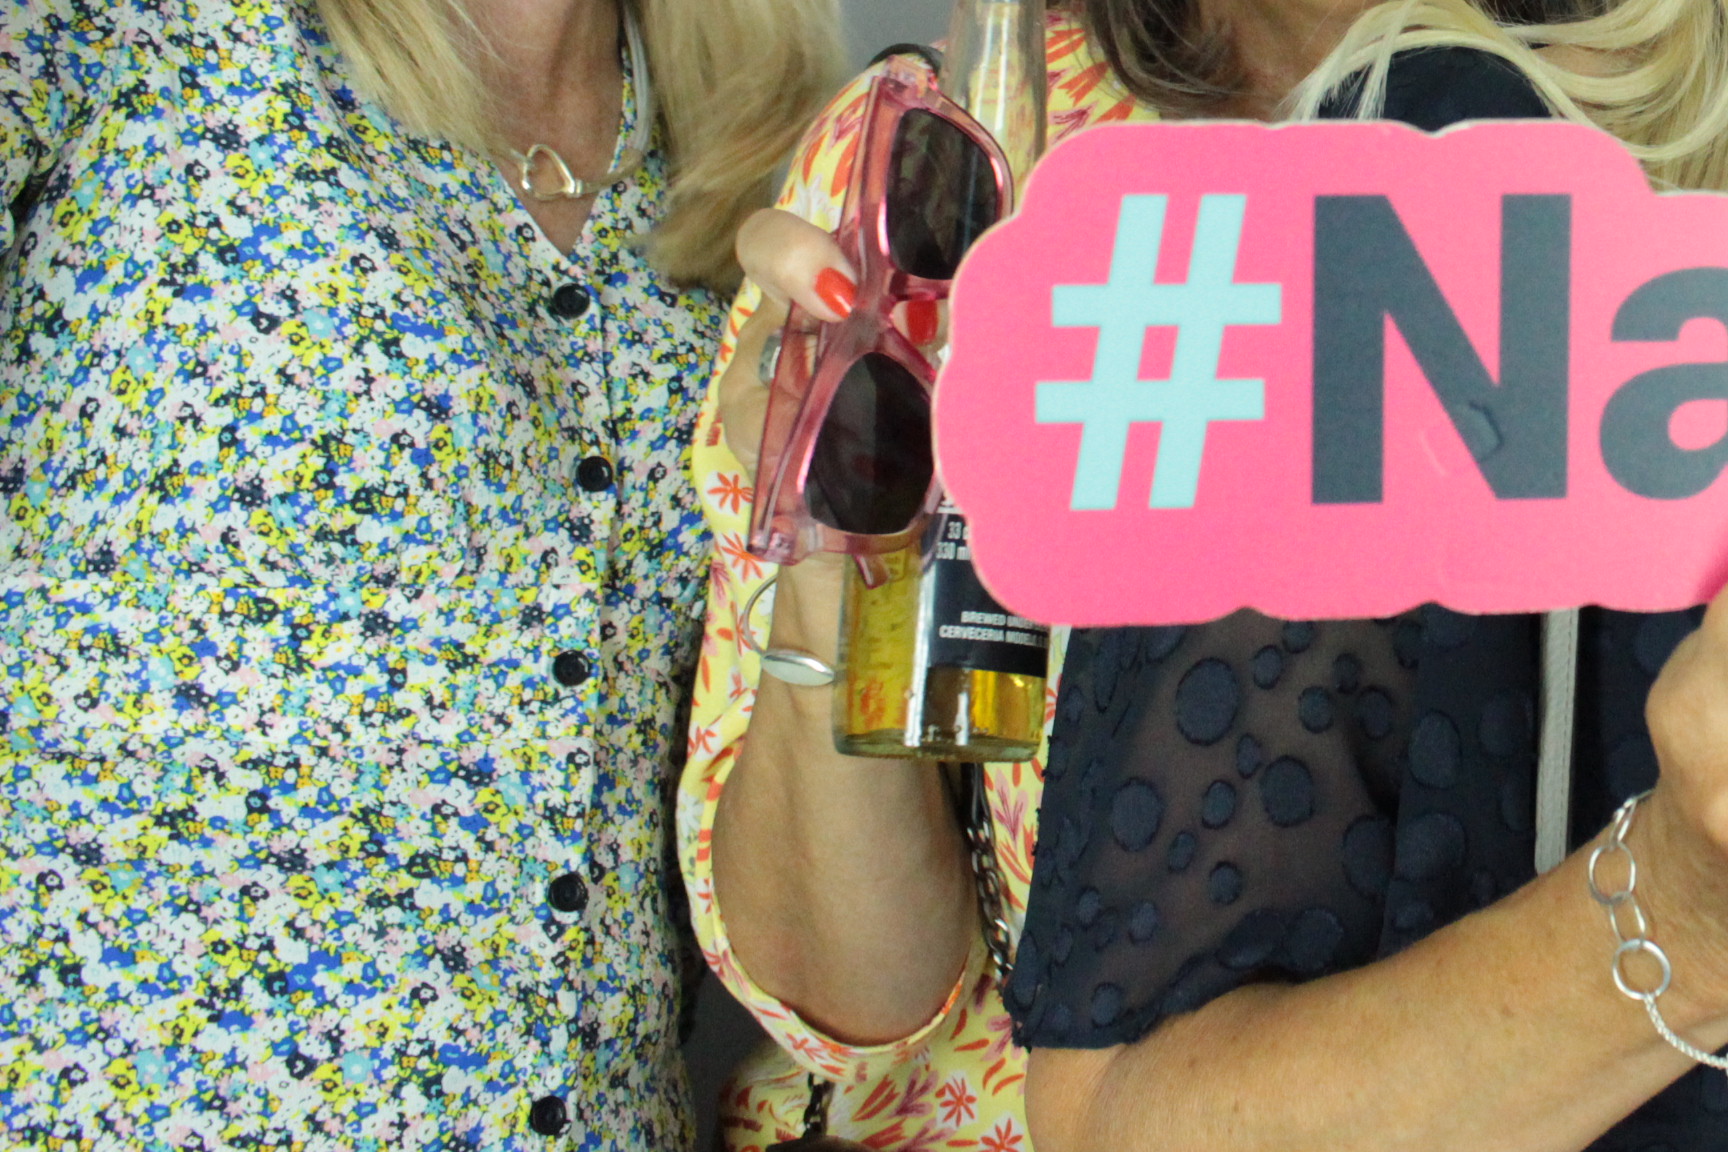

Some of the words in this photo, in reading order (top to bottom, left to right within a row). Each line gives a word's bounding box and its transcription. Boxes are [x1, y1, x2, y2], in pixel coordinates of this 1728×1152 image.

[947, 521, 962, 539] 33
[960, 610, 1006, 626] BREWED
[938, 624, 1004, 642] CERVECERIA
